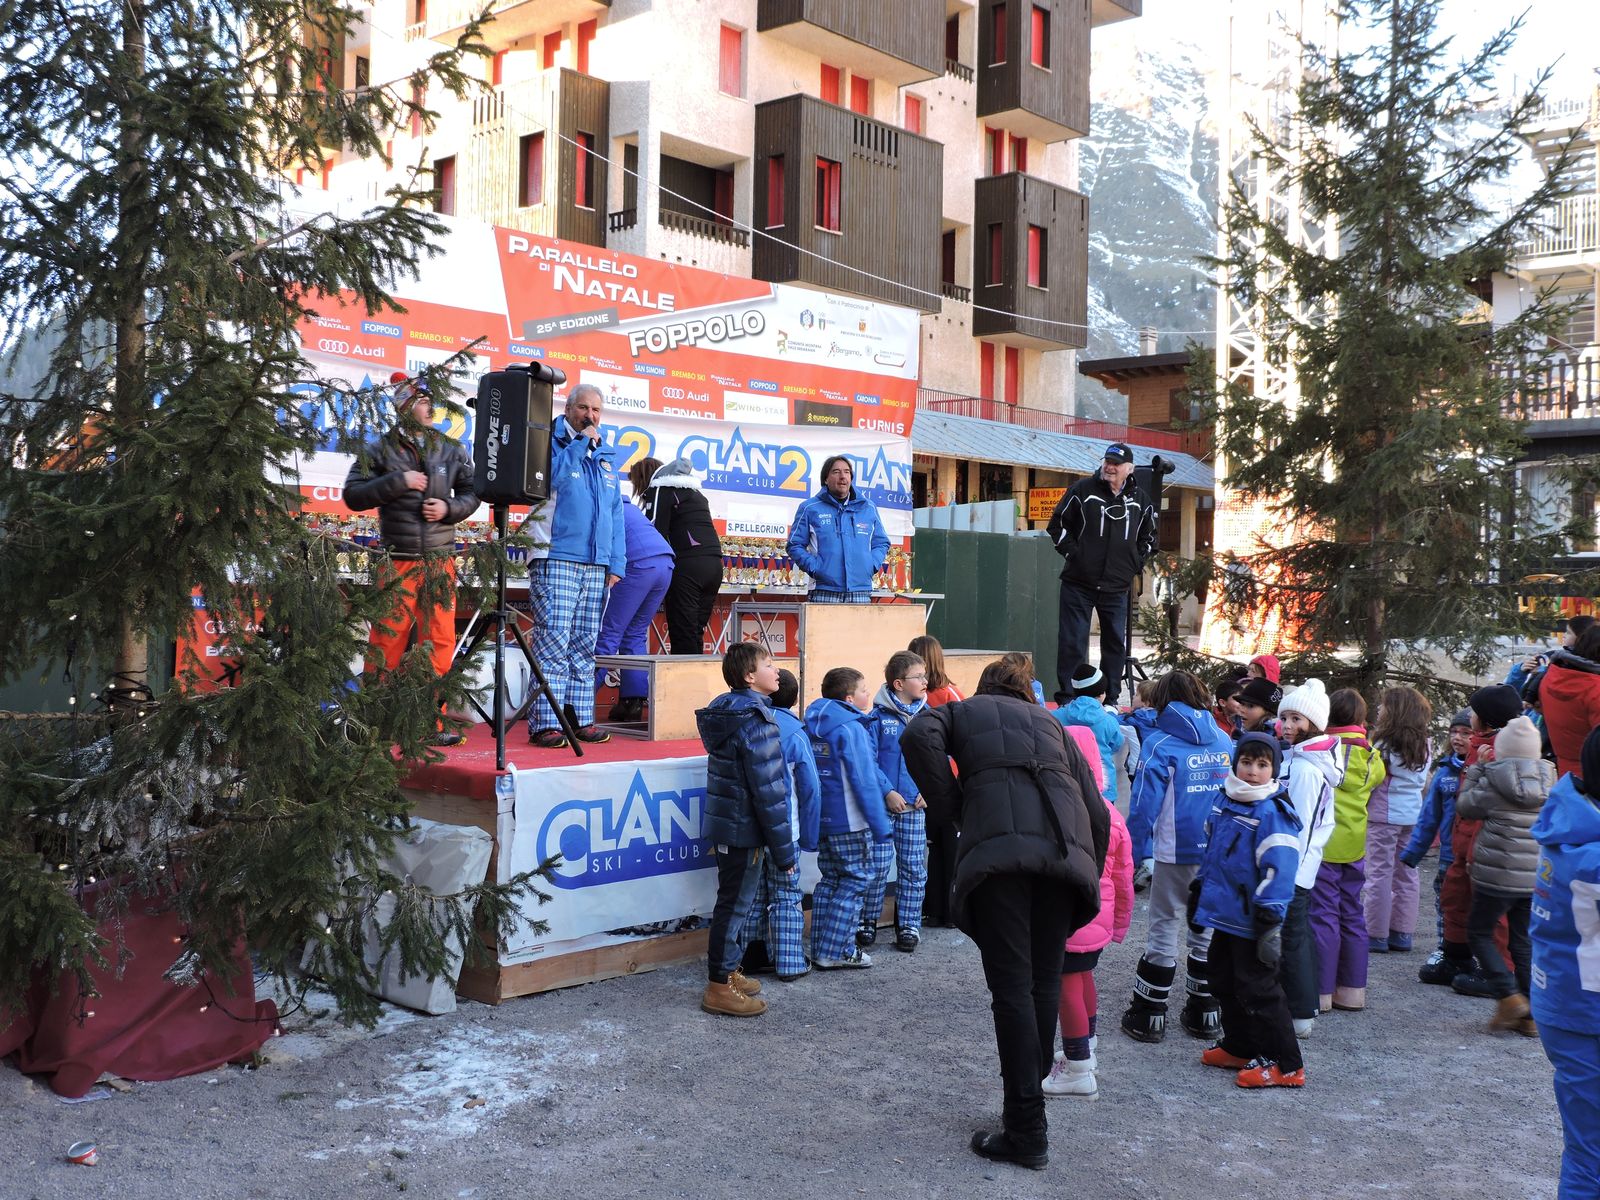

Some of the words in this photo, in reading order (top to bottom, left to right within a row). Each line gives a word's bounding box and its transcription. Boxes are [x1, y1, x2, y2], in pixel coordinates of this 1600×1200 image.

[508, 235, 638, 278] PARALLELO
[539, 263, 550, 272] DI
[553, 265, 675, 311] NATALE
[318, 320, 351, 331] NATALE
[559, 314, 609, 330] EDIZIONE
[364, 323, 399, 336] FOPPOLO
[628, 310, 765, 357] FOPPOLO
[410, 331, 440, 342] BREMBO
[442, 335, 453, 343] SKI
[353, 344, 385, 358] Audi
[512, 345, 541, 357] CARONA
[548, 351, 576, 361] BREMBO
[634, 364, 645, 373] SAN
[646, 365, 665, 376] SIMONE
[671, 369, 696, 379] BREMBO
[750, 380, 776, 391] FOPPOLO
[783, 385, 807, 395] BREMBO
[490, 388, 501, 415] 100
[687, 391, 709, 402] Audi
[858, 418, 904, 434] CURNIS
[487, 416, 499, 469] MOVE
[710, 473, 728, 483] SKI
[748, 477, 775, 488] CLUB
[1030, 490, 1050, 498] ANNA
[728, 523, 785, 534] S.PELLEGRINO
[1188, 753, 1230, 769] CLAN2
[545, 790, 701, 878] CLAN
[592, 856, 621, 873] SKI
[655, 845, 700, 863] CLUB
